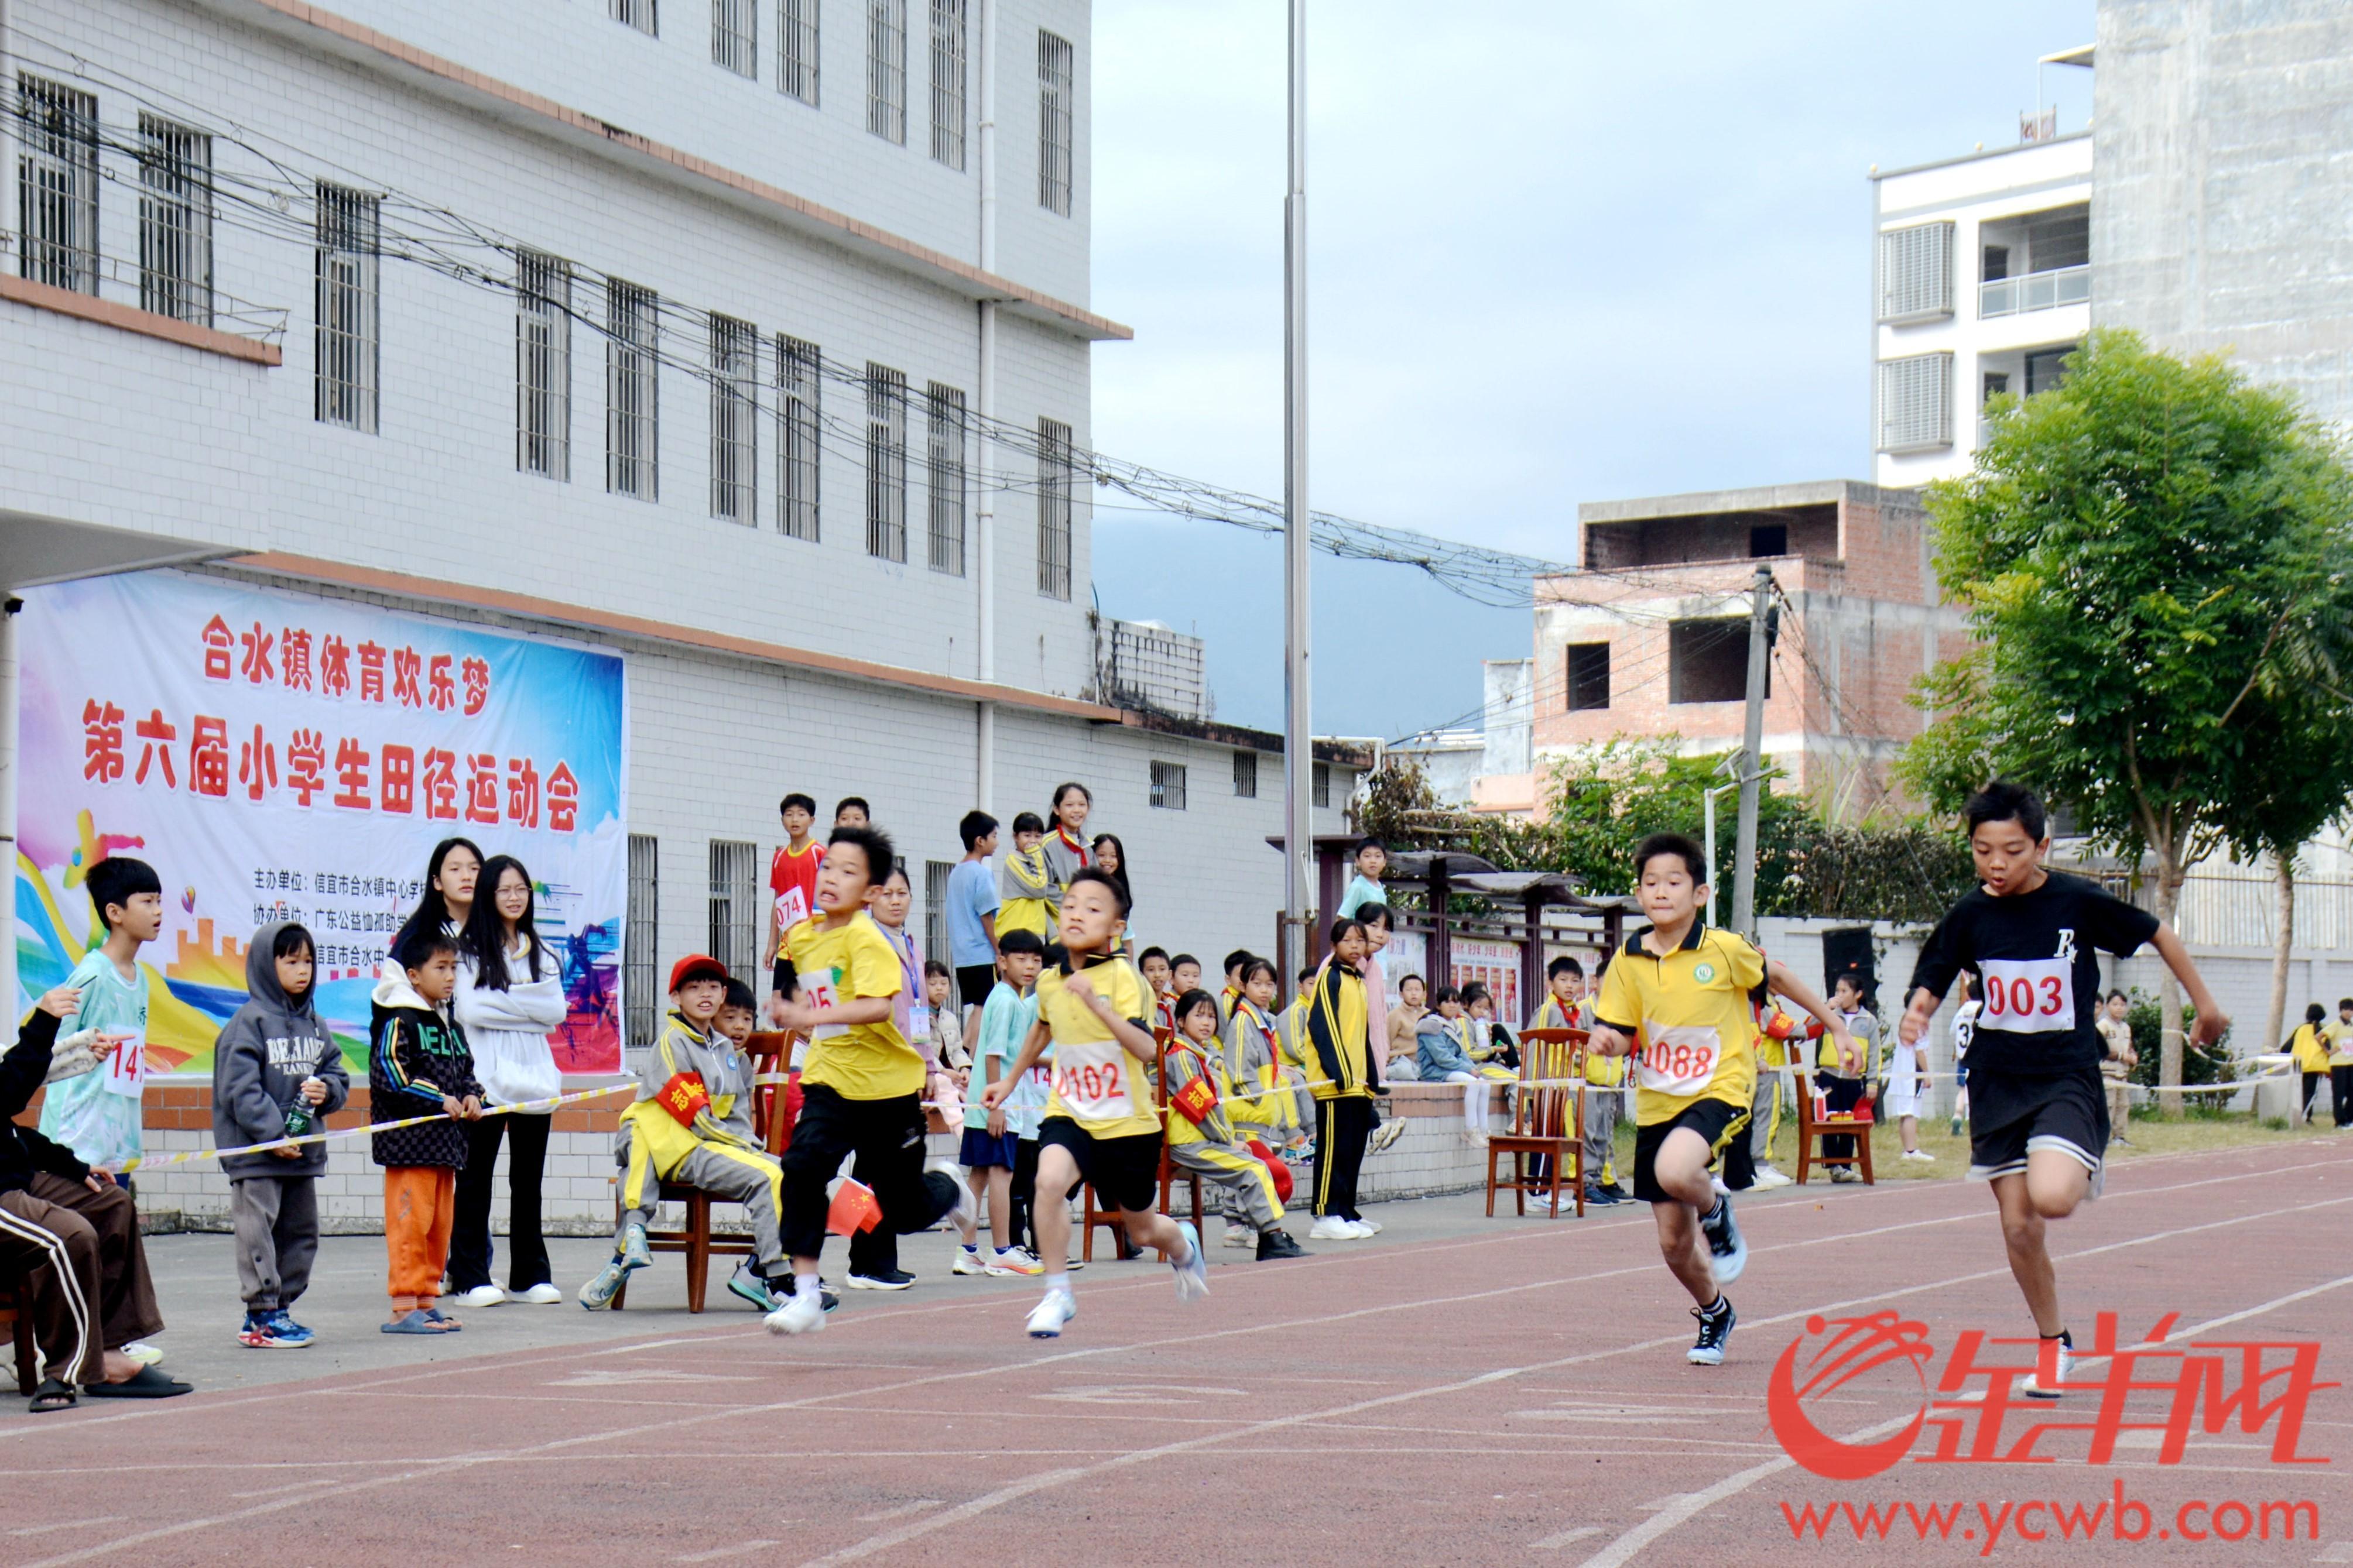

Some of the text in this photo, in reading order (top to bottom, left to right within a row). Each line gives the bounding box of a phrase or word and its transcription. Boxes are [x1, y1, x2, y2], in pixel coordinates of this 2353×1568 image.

[201, 613, 491, 717] 合水镇体育欢乐梦
[82, 698, 579, 832] 第六届小学生田径运动会
[1988, 975, 2063, 1016] 003
